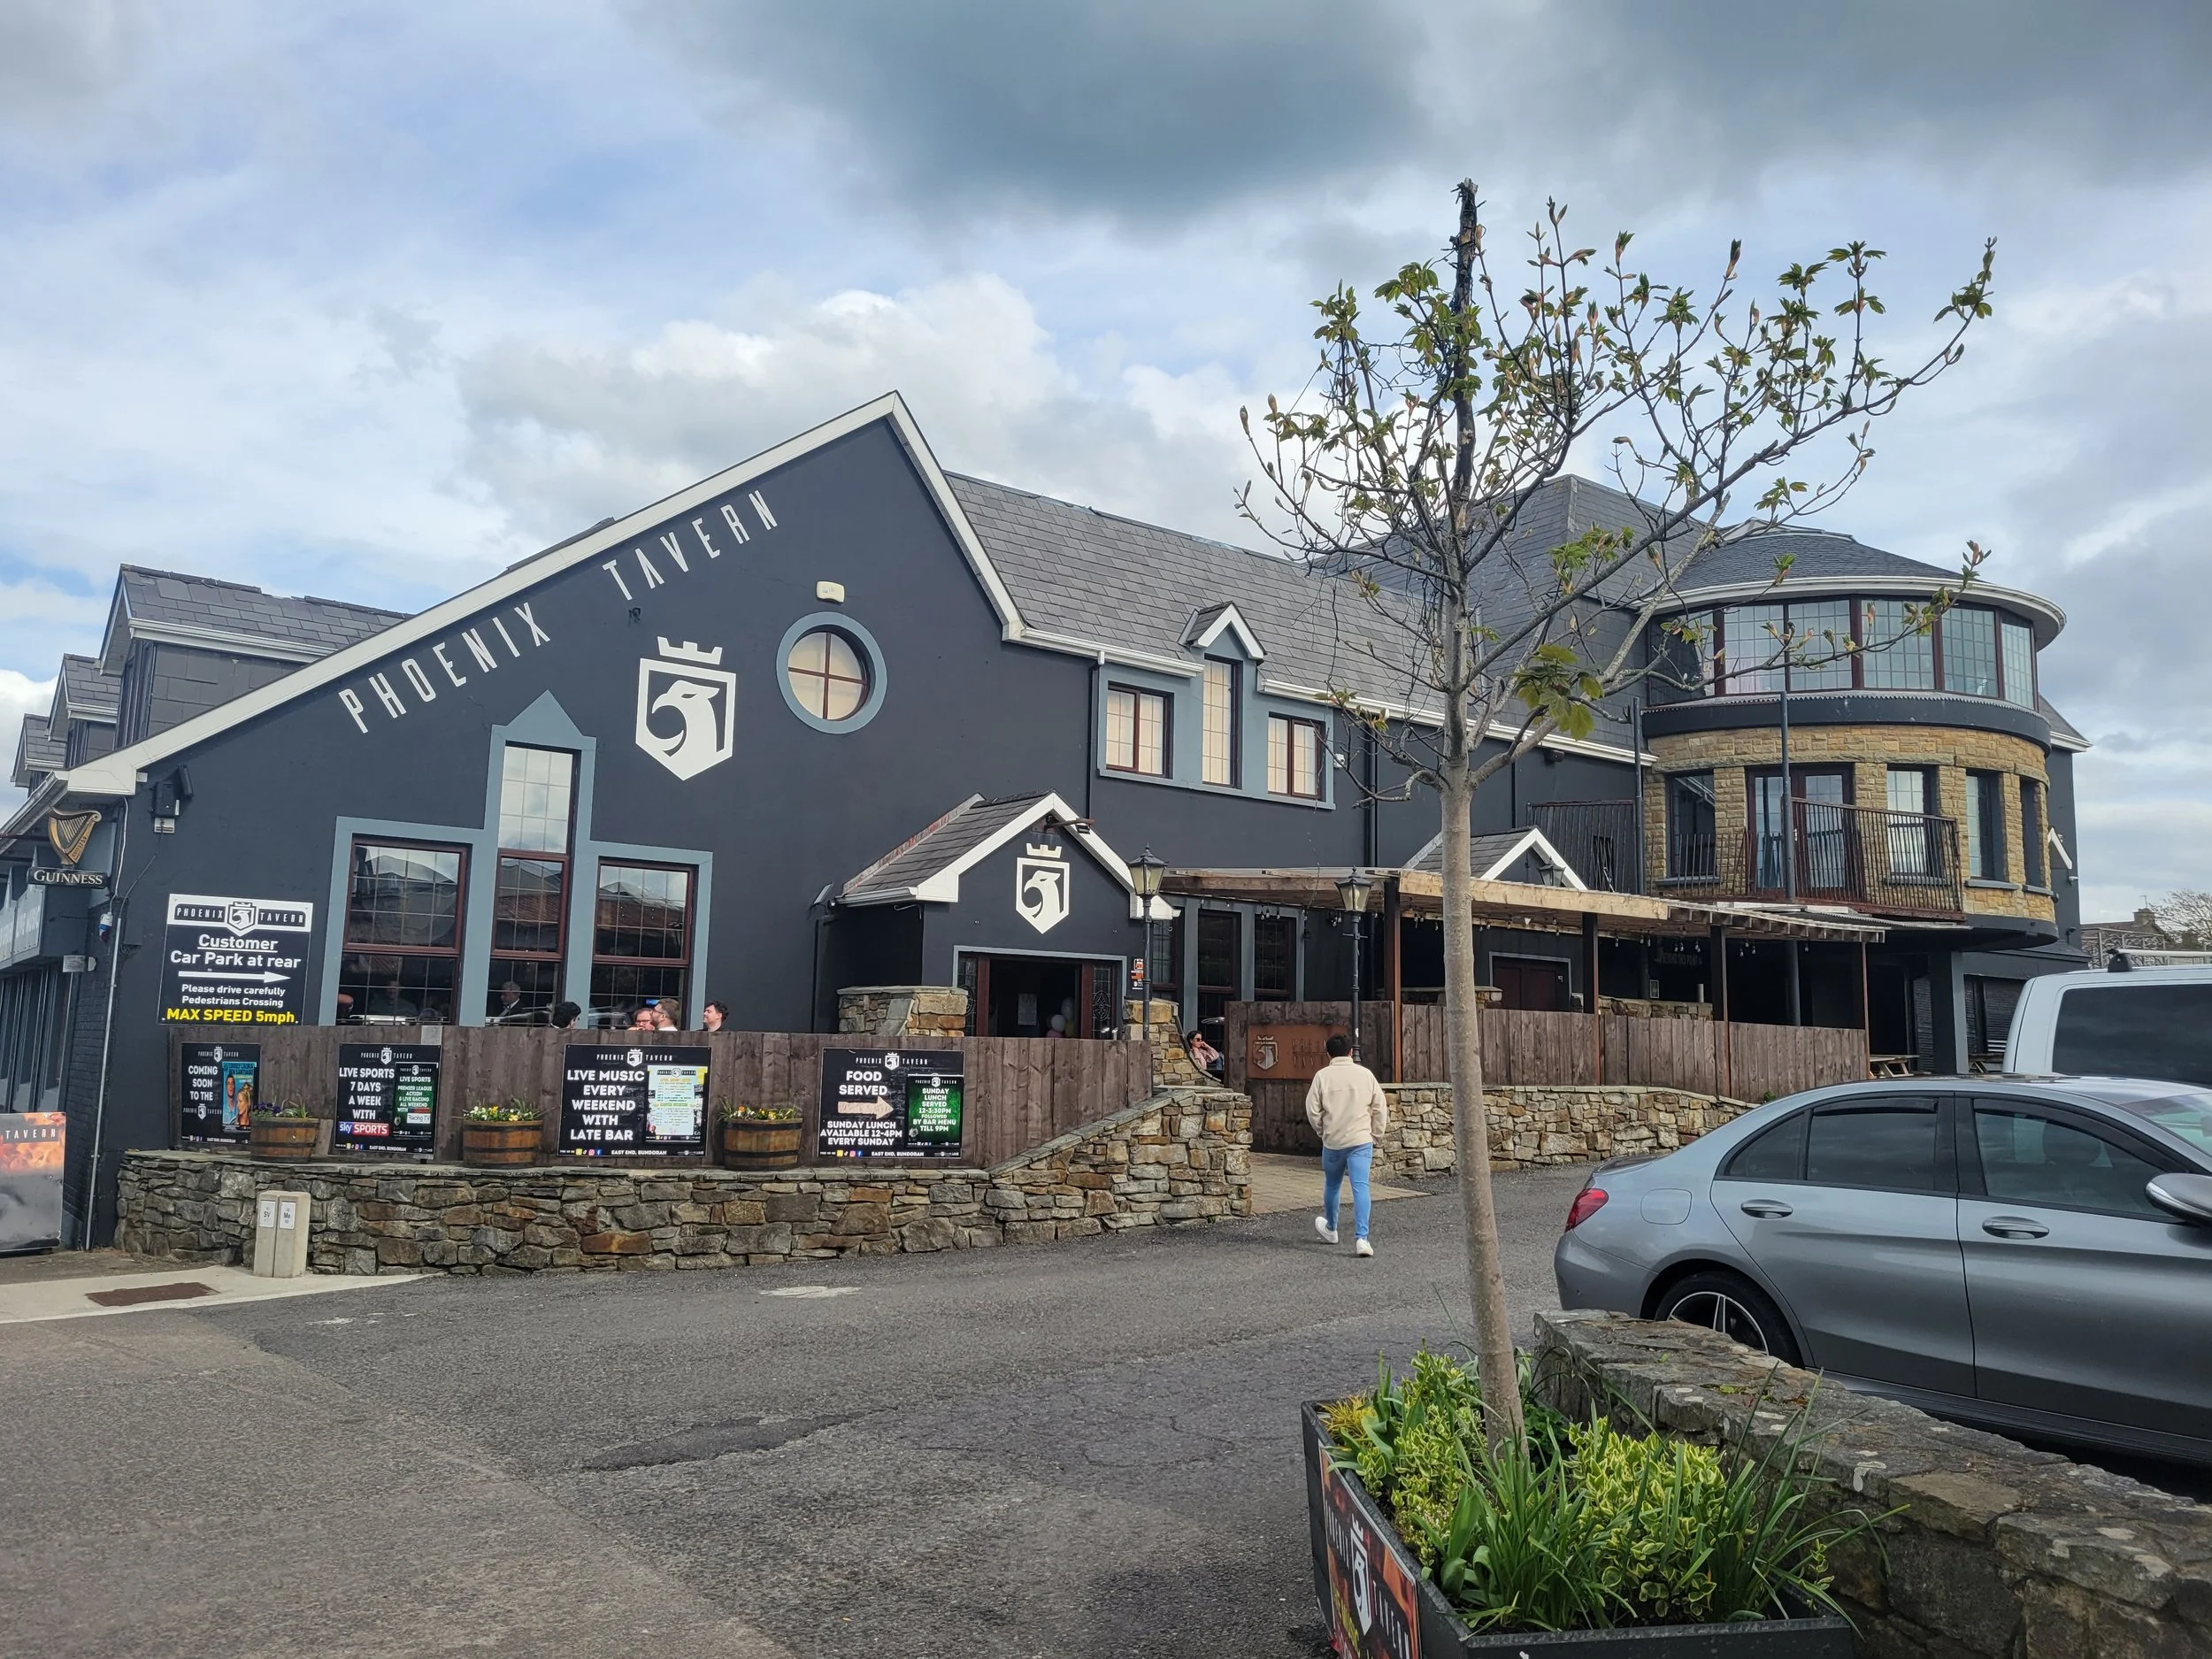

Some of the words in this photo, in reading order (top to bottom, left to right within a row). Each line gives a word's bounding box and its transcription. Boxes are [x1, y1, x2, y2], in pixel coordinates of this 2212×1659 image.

[338, 603, 550, 733] PHOENIX
[603, 490, 778, 600] TAVERN
[34, 870, 103, 885] GUINNESS
[177, 907, 223, 919] PHOENIX
[260, 912, 303, 924] TAVERN
[198, 933, 279, 950] Customer
[170, 950, 201, 964] Car
[204, 952, 243, 966] Park
[247, 956, 263, 967] at
[267, 956, 302, 968] rear
[181, 984, 215, 993] Please
[217, 985, 242, 994] drive
[244, 987, 286, 996] carefully
[182, 995, 240, 1005] Pedestrians
[242, 998, 284, 1009] Crossing
[166, 1008, 200, 1020] MAX
[204, 1010, 252, 1022] SPEED
[256, 1010, 295, 1025] 5mph
[188, 1065, 218, 1075] COMING
[339, 1067, 358, 1078] LIVE
[359, 1068, 395, 1079] SPORTS
[567, 1070, 595, 1080] LIVE
[599, 1071, 645, 1081] MUSIC
[846, 1071, 882, 1081] FOOD
[192, 1079, 212, 1087] SOON
[350, 1081, 356, 1091] 7
[357, 1082, 381, 1092] DAYS
[583, 1085, 626, 1095] EVERY
[839, 1085, 888, 1095] SERVED
[189, 1091, 199, 1100] TO
[200, 1091, 213, 1101] THE
[349, 1095, 355, 1105] A
[357, 1095, 381, 1106] WEEK
[572, 1099, 636, 1111] WEEKEND
[352, 1110, 376, 1119] WITH
[582, 1115, 618, 1125] WITH
[5, 1128, 56, 1139] TAVERN
[339, 1122, 352, 1133] sky
[354, 1124, 388, 1134] SPORTS
[570, 1129, 602, 1140] LATE
[605, 1130, 634, 1141] BAR
